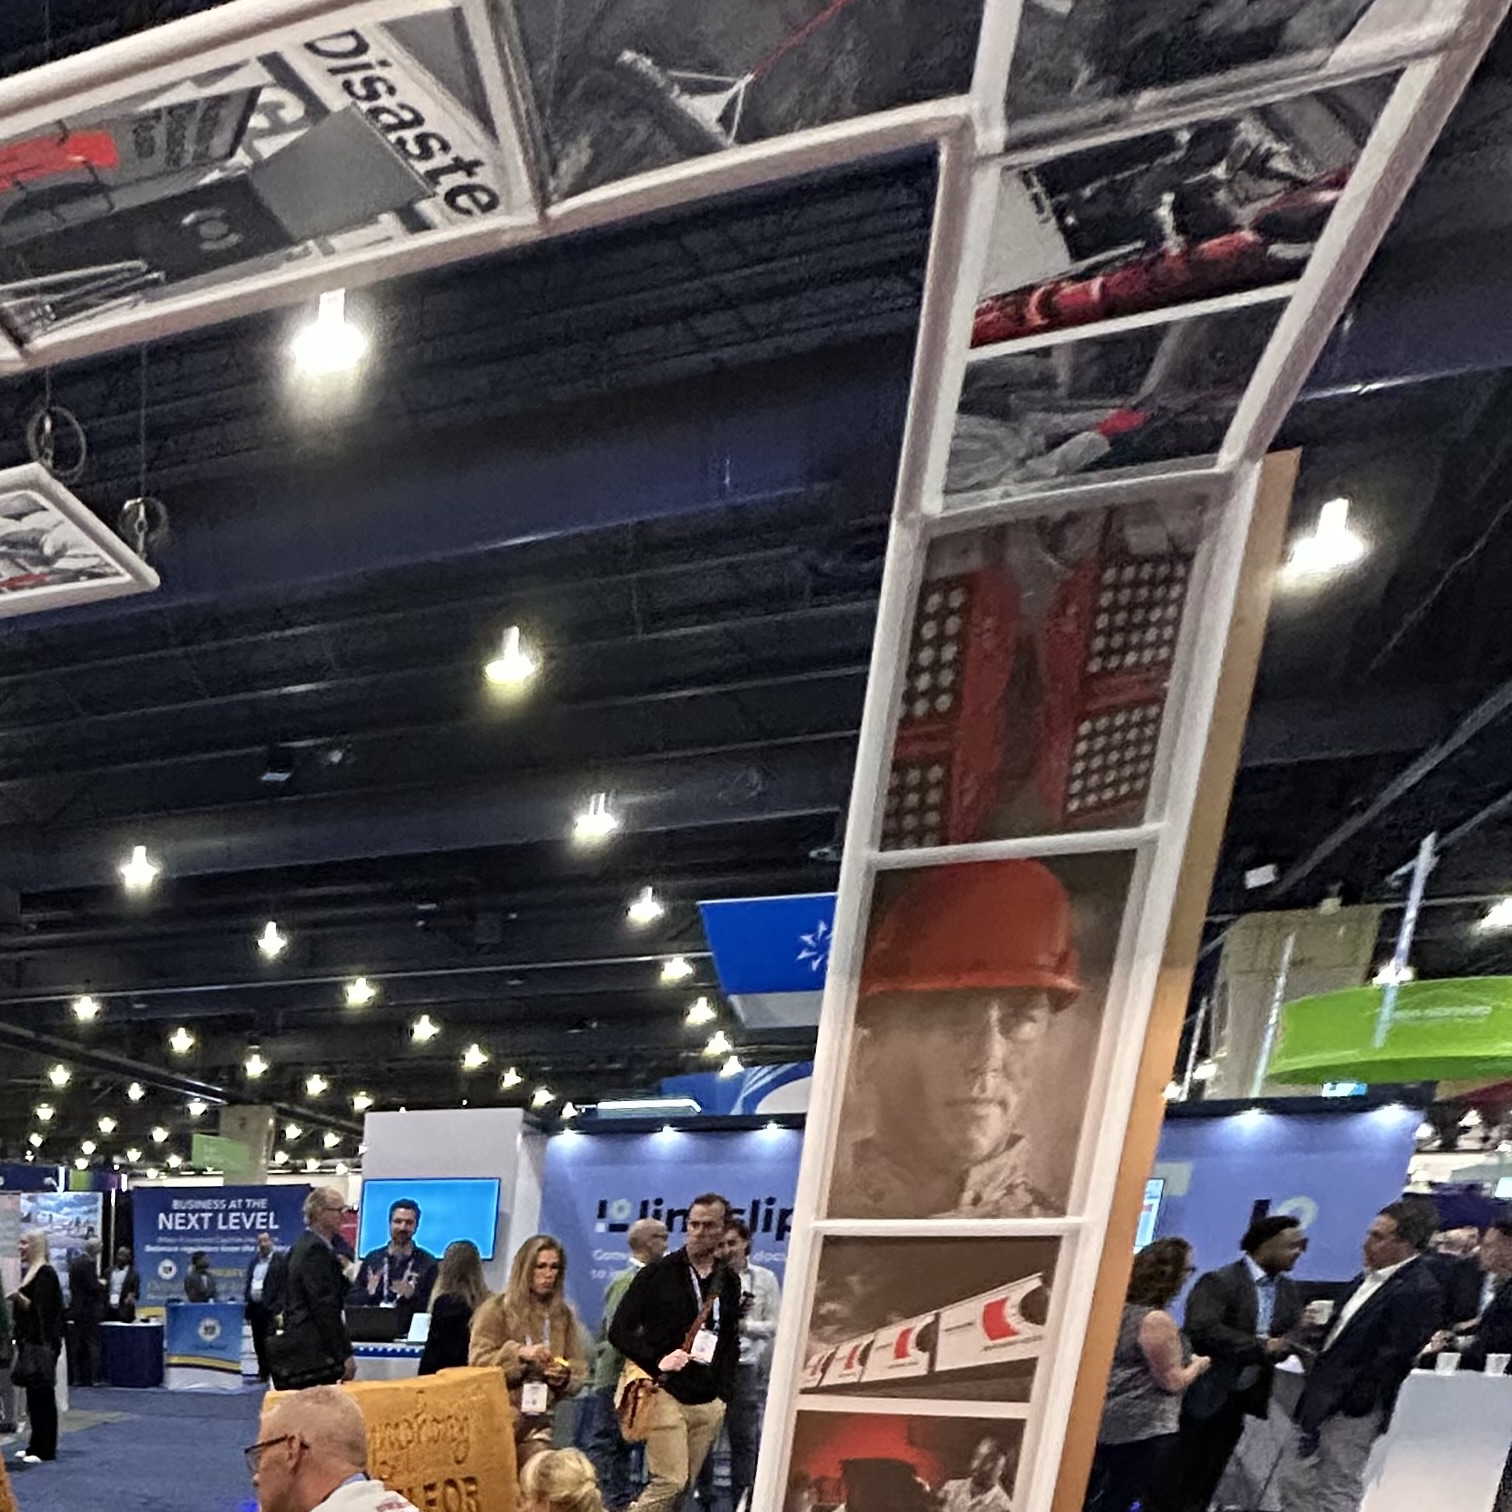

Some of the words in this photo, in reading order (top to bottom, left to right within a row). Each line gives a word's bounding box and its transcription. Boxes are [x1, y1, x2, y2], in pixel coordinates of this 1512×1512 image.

[172, 1199, 226, 1210] BUSINESS
[228, 1199, 245, 1209] AT
[245, 1198, 268, 1209] THE
[158, 1212, 213, 1230] NEXT
[217, 1211, 280, 1230] LEVEL
